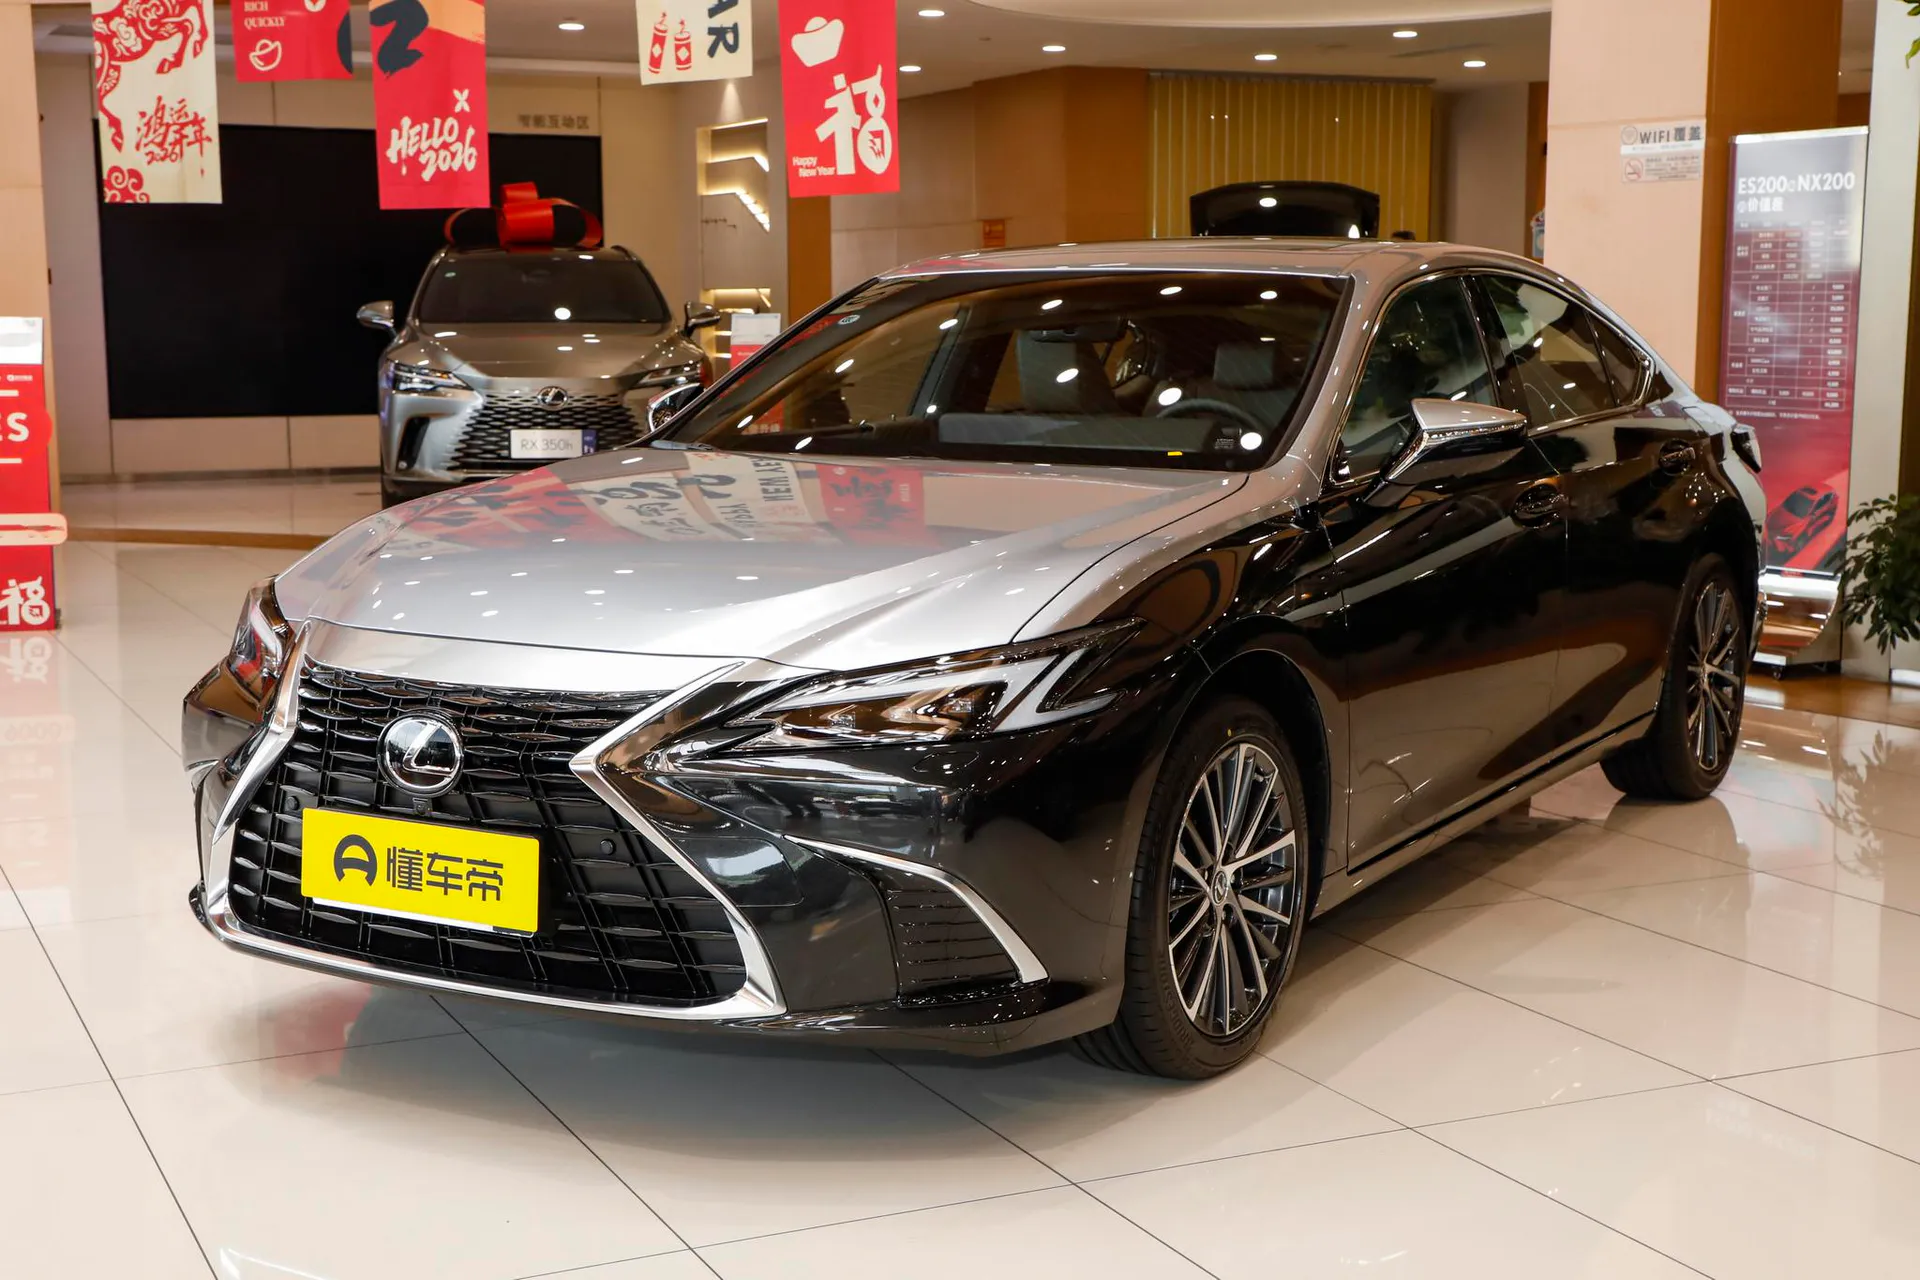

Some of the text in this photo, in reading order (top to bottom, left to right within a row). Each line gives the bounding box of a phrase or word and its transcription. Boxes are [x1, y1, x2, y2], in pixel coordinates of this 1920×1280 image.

[244, 1, 268, 12] RICH
[244, 16, 285, 30] QUICKLY
[815, 64, 892, 174] 福
[386, 116, 459, 166] HELLO
[1640, 129, 1671, 144] WIFI
[418, 125, 478, 182] 2026
[793, 156, 818, 168] Happy
[798, 166, 836, 177] New Year
[1738, 175, 1787, 194] ES200
[1798, 172, 1856, 192] NX200
[0, 411, 30, 443] S
[521, 438, 538, 451] RX
[540, 439, 574, 451] 350h
[0, 576, 50, 626] 福
